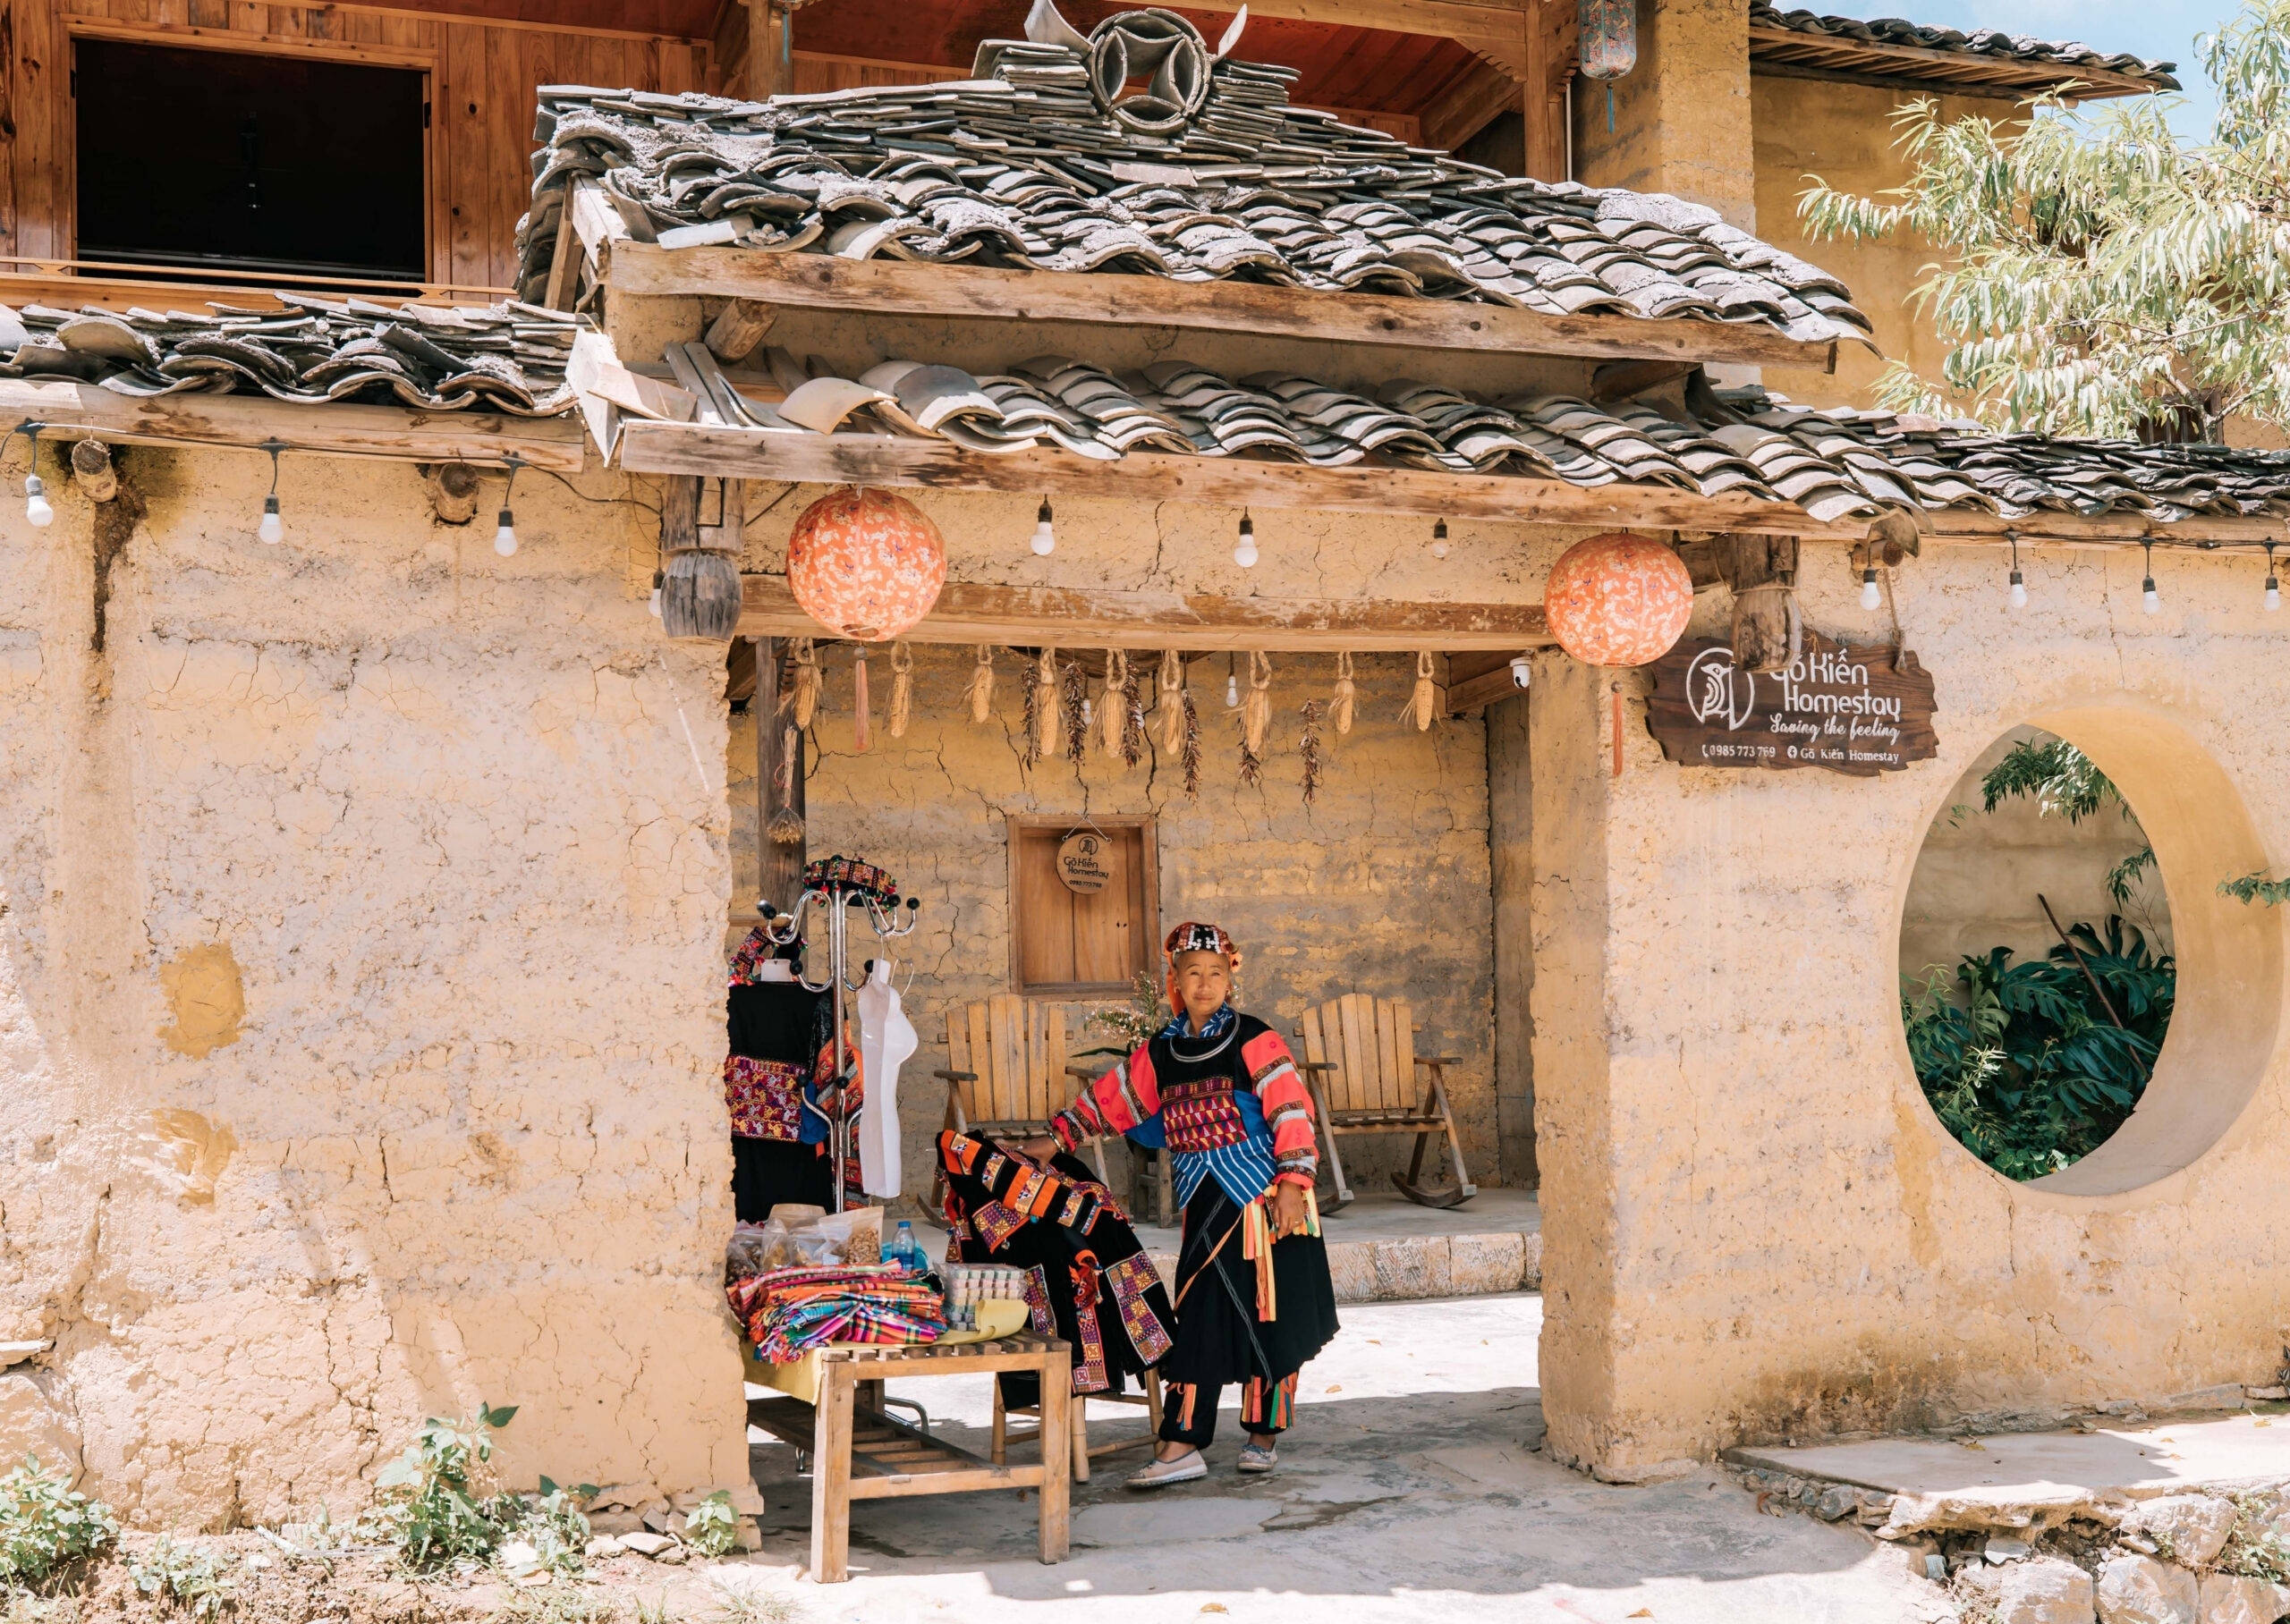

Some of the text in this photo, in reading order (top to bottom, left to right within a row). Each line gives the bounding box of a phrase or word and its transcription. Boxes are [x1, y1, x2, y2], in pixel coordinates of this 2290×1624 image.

[1810, 647, 1869, 685] Kiến
[1784, 684, 1901, 723] Homestay
[1769, 713, 1900, 746] Saving the feeling
[1849, 749, 1899, 764] Homestay
[1068, 865, 1108, 880] Homestay
